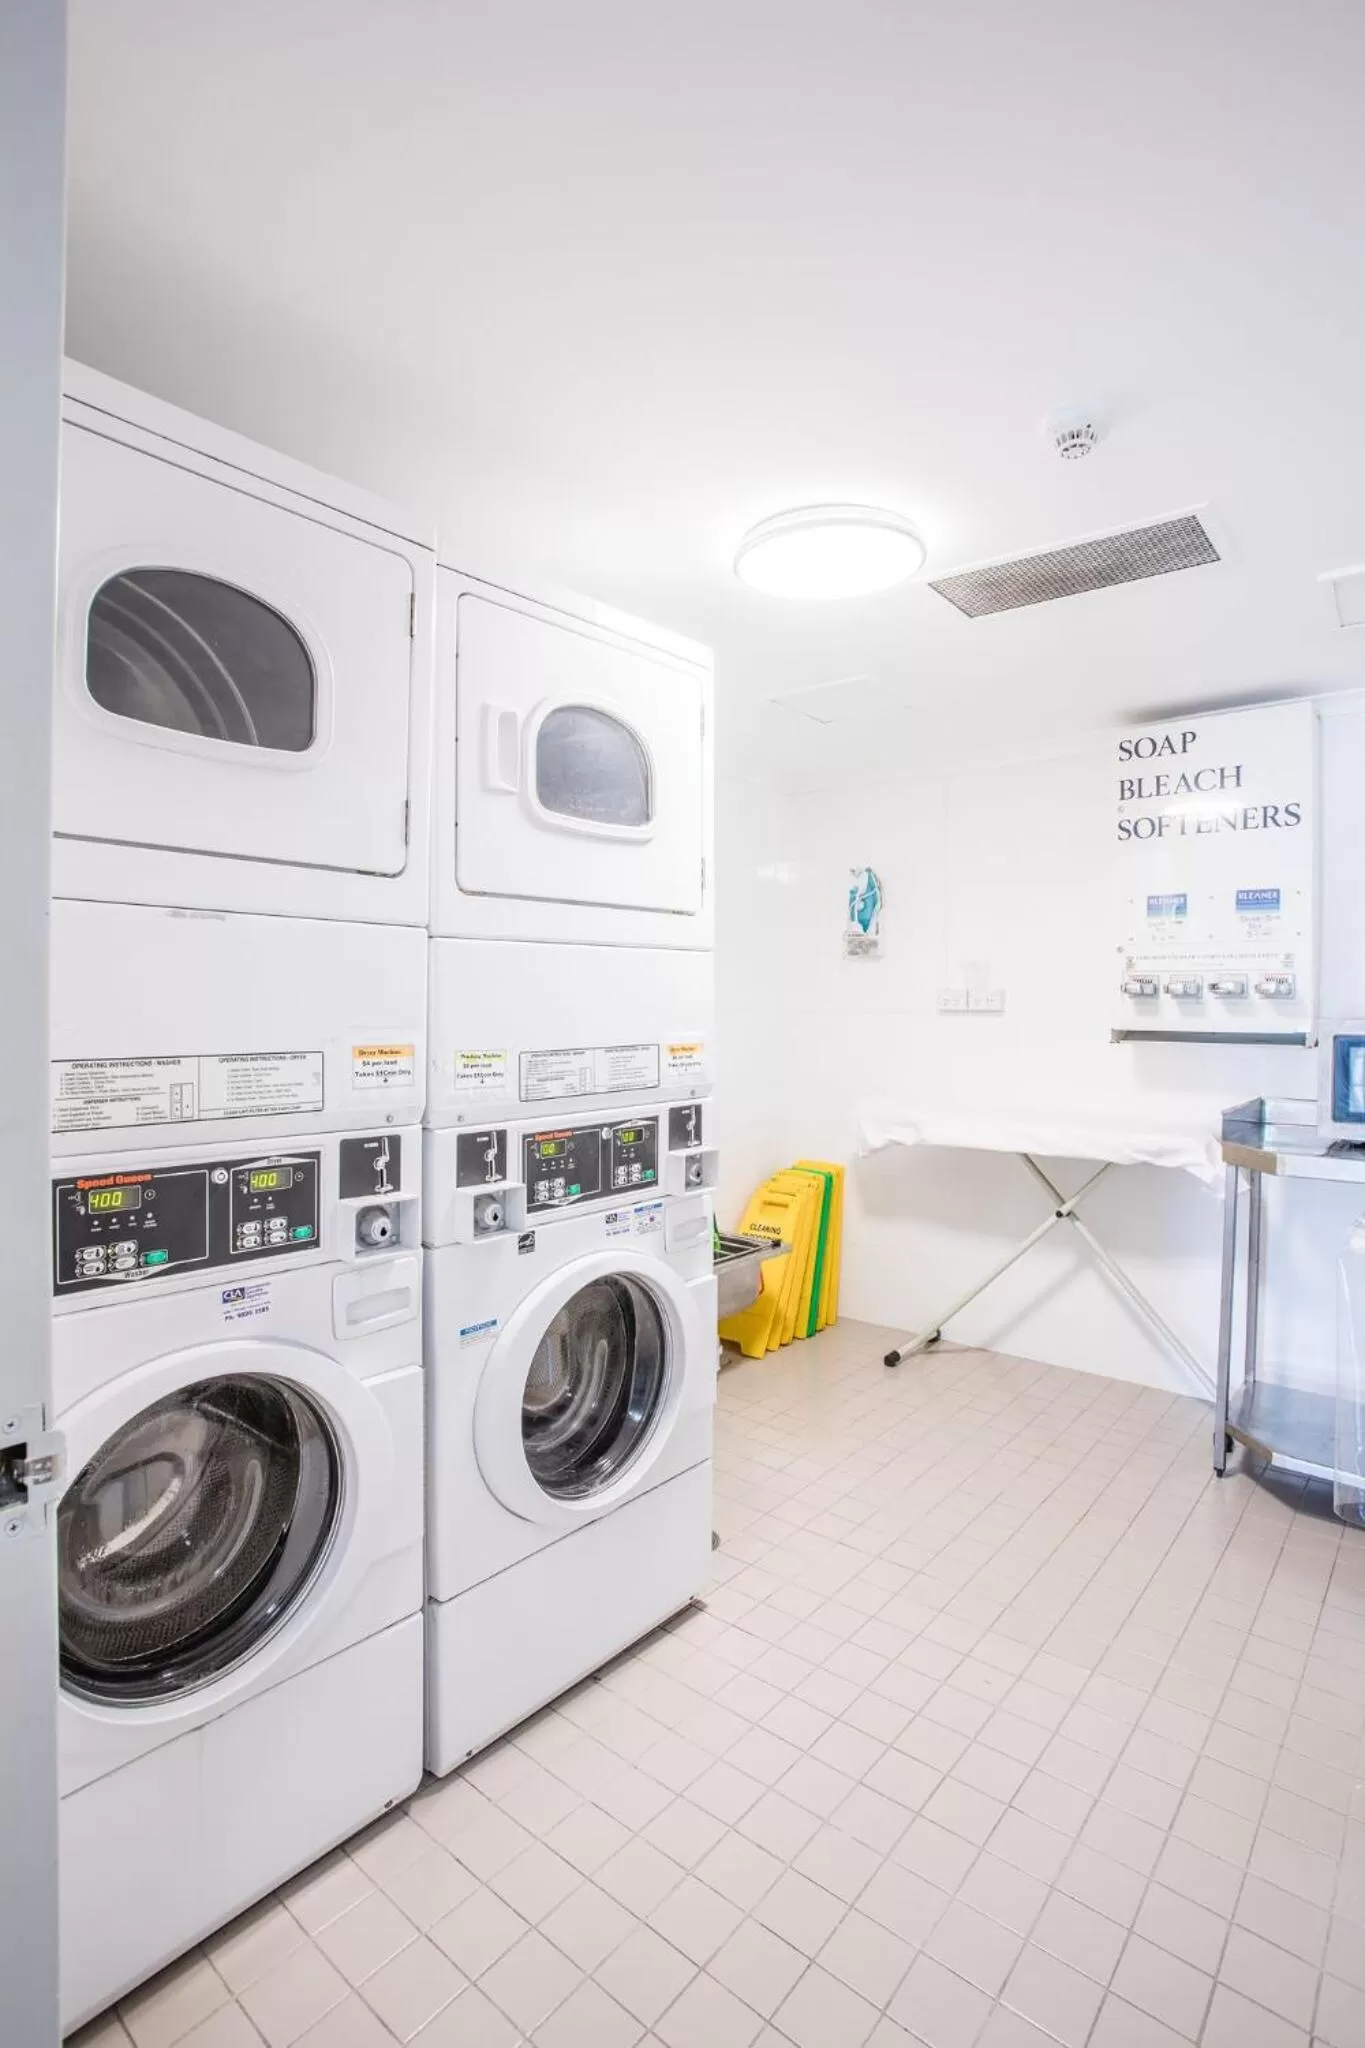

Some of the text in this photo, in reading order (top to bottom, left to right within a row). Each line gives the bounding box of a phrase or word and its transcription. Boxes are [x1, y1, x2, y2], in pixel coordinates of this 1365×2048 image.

[1118, 731, 1197, 762] SOAP
[1119, 765, 1243, 801] BLEACH
[1117, 802, 1302, 841] SOFTENERS
[71, 1061, 108, 1069] OPERATING
[108, 1060, 153, 1068] INSTRUCTIONS
[76, 1174, 152, 1190] Speed Queen
[251, 1172, 277, 1188] 400
[90, 1191, 122, 1208] 400
[750, 1223, 781, 1235] CLEANING
[223, 1289, 243, 1300] CLA
